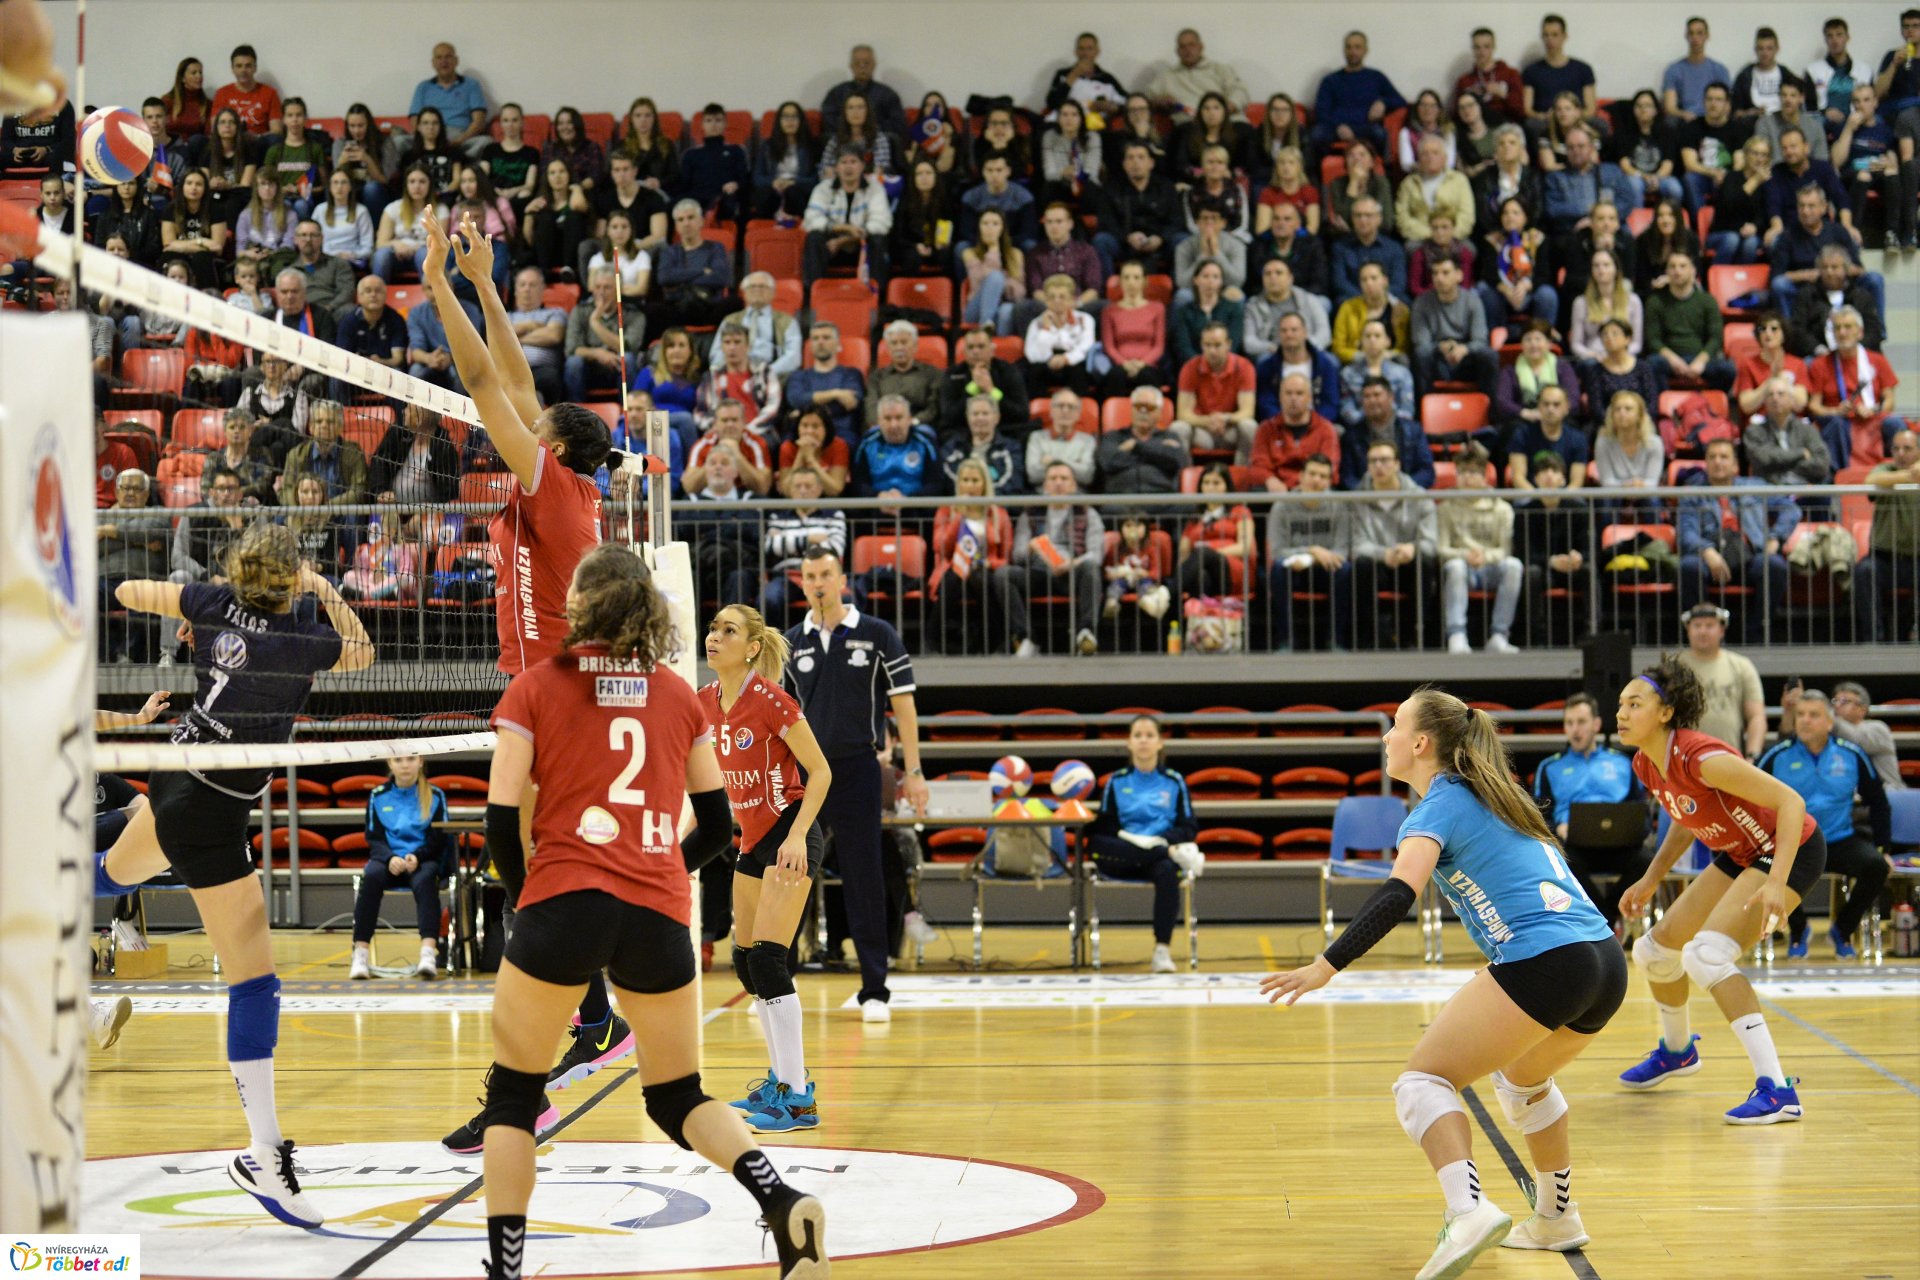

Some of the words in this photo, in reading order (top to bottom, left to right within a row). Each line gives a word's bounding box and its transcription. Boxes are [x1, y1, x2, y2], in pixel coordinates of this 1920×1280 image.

[599, 680, 645, 696] FATUM
[720, 724, 731, 756] 5
[609, 716, 646, 806] 2
